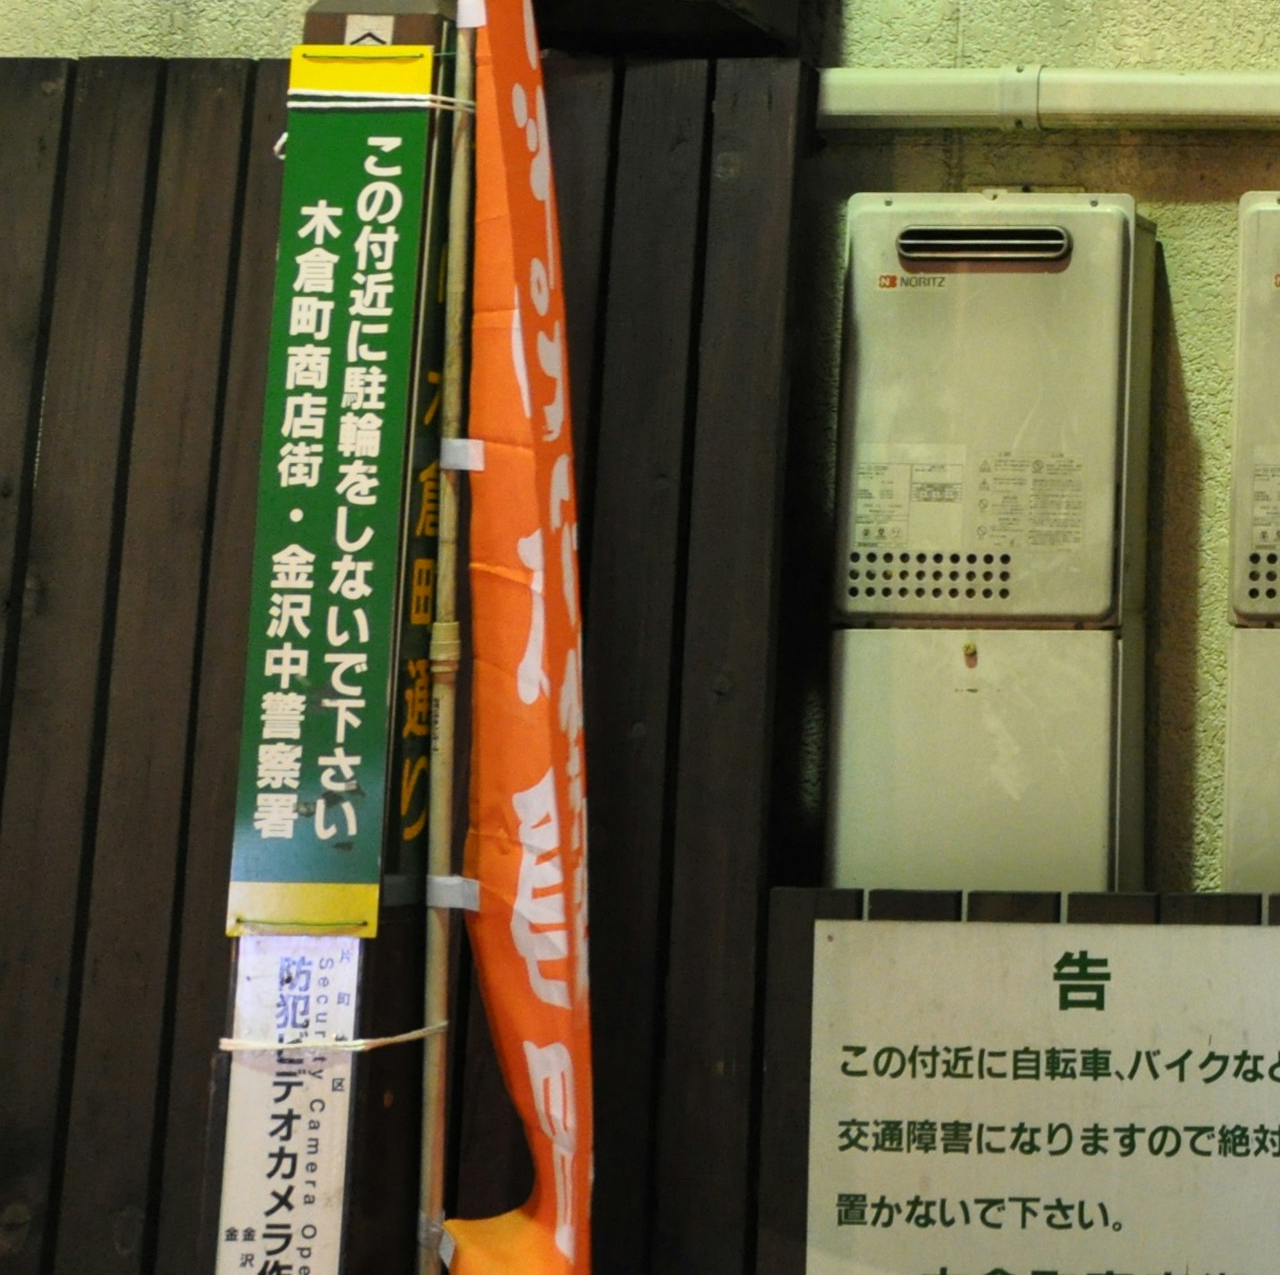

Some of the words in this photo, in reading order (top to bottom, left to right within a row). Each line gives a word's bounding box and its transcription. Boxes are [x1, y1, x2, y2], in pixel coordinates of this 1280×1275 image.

[900, 276, 945, 287] NORITZ
[314, 136, 403, 839] この付近に駐輪をしないで下さい
[252, 199, 344, 839] 木倉町商店街・金沢中警察署
[1053, 951, 1111, 1011] 告
[308, 958, 335, 1080] Securty
[303, 1098, 326, 1205] Camera
[225, 1227, 239, 1242] 金
[836, 1192, 1123, 1233] 置かないで下さい。
[240, 1227, 257, 1268] 金沢
